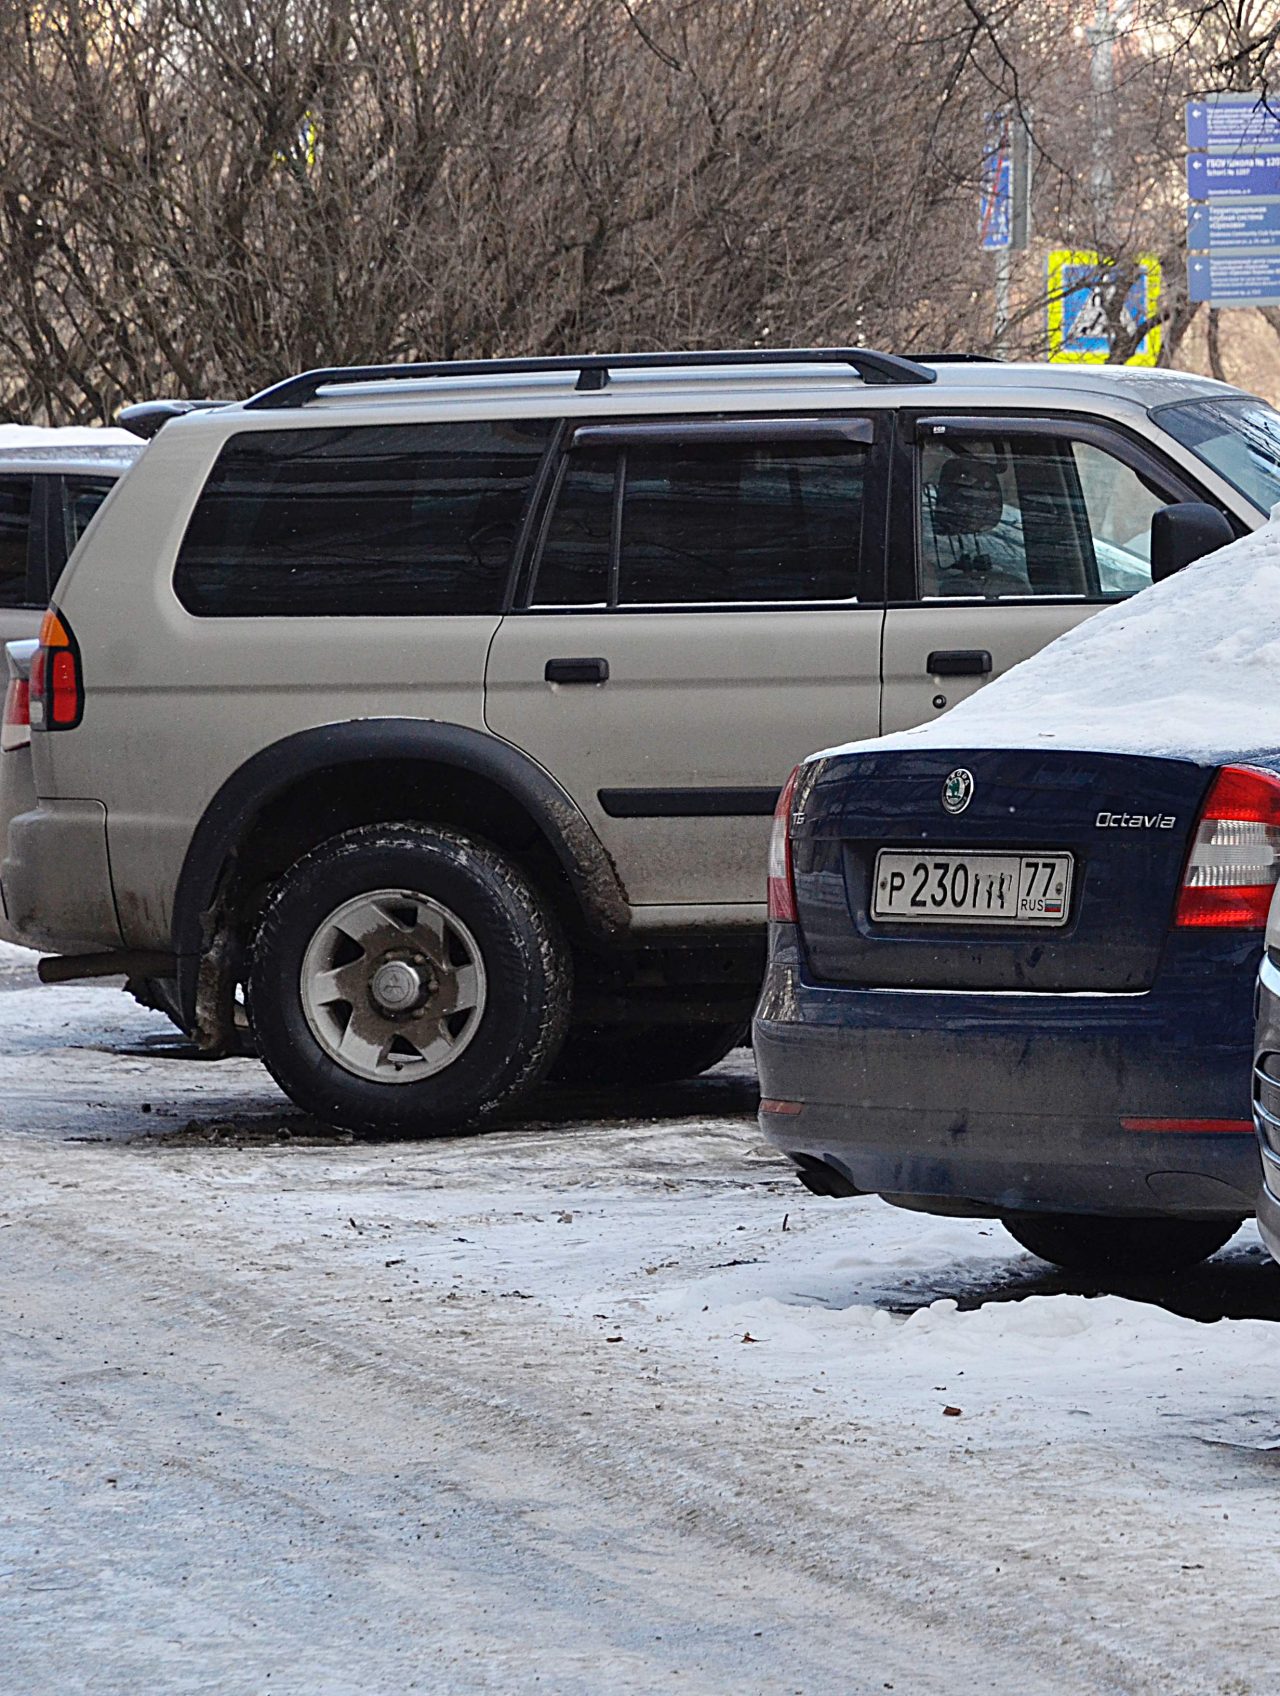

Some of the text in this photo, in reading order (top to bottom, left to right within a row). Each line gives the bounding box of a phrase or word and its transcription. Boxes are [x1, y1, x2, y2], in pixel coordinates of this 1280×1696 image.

[1095, 811, 1176, 830] Octavia
[1025, 862, 1056, 897] 77
[1020, 898, 1044, 912] RUS
